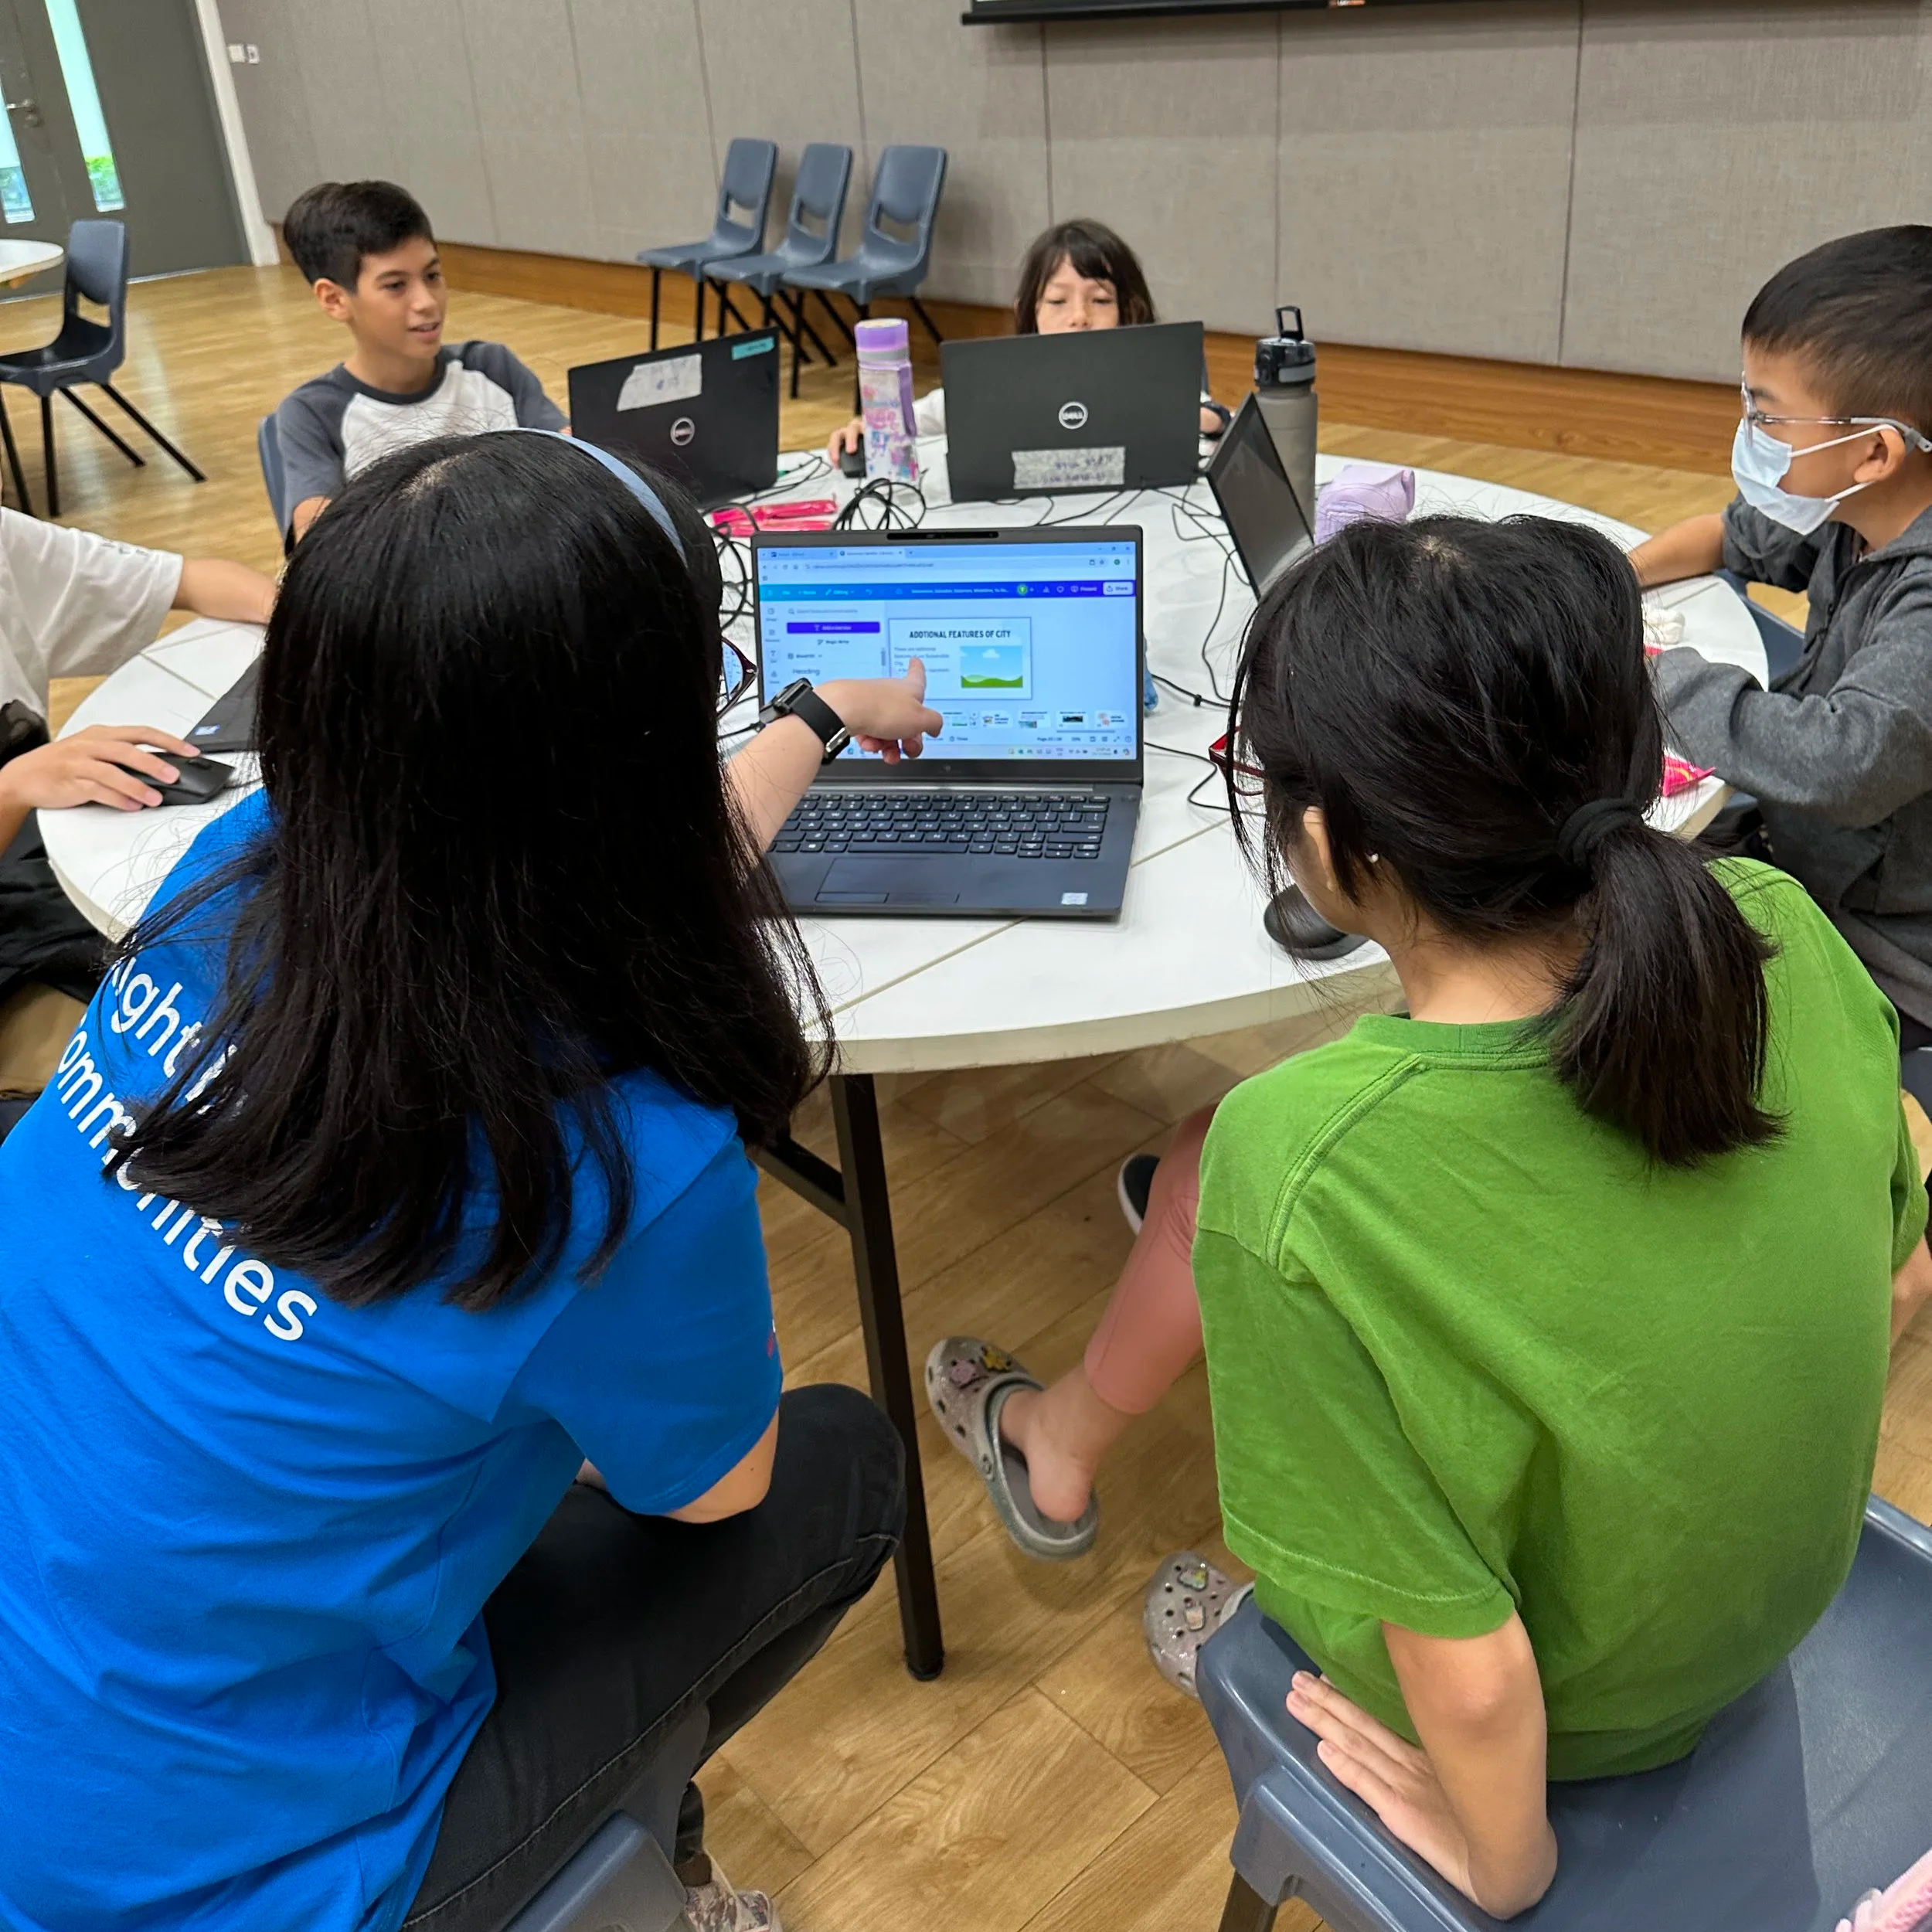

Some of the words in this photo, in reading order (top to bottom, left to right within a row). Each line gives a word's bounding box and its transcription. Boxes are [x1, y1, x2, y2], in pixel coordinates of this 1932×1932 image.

[948, 630, 985, 638] FEATURES
[985, 630, 995, 638] OF
[995, 630, 1011, 638] CITY
[57, 1012, 318, 1341] ommuities
